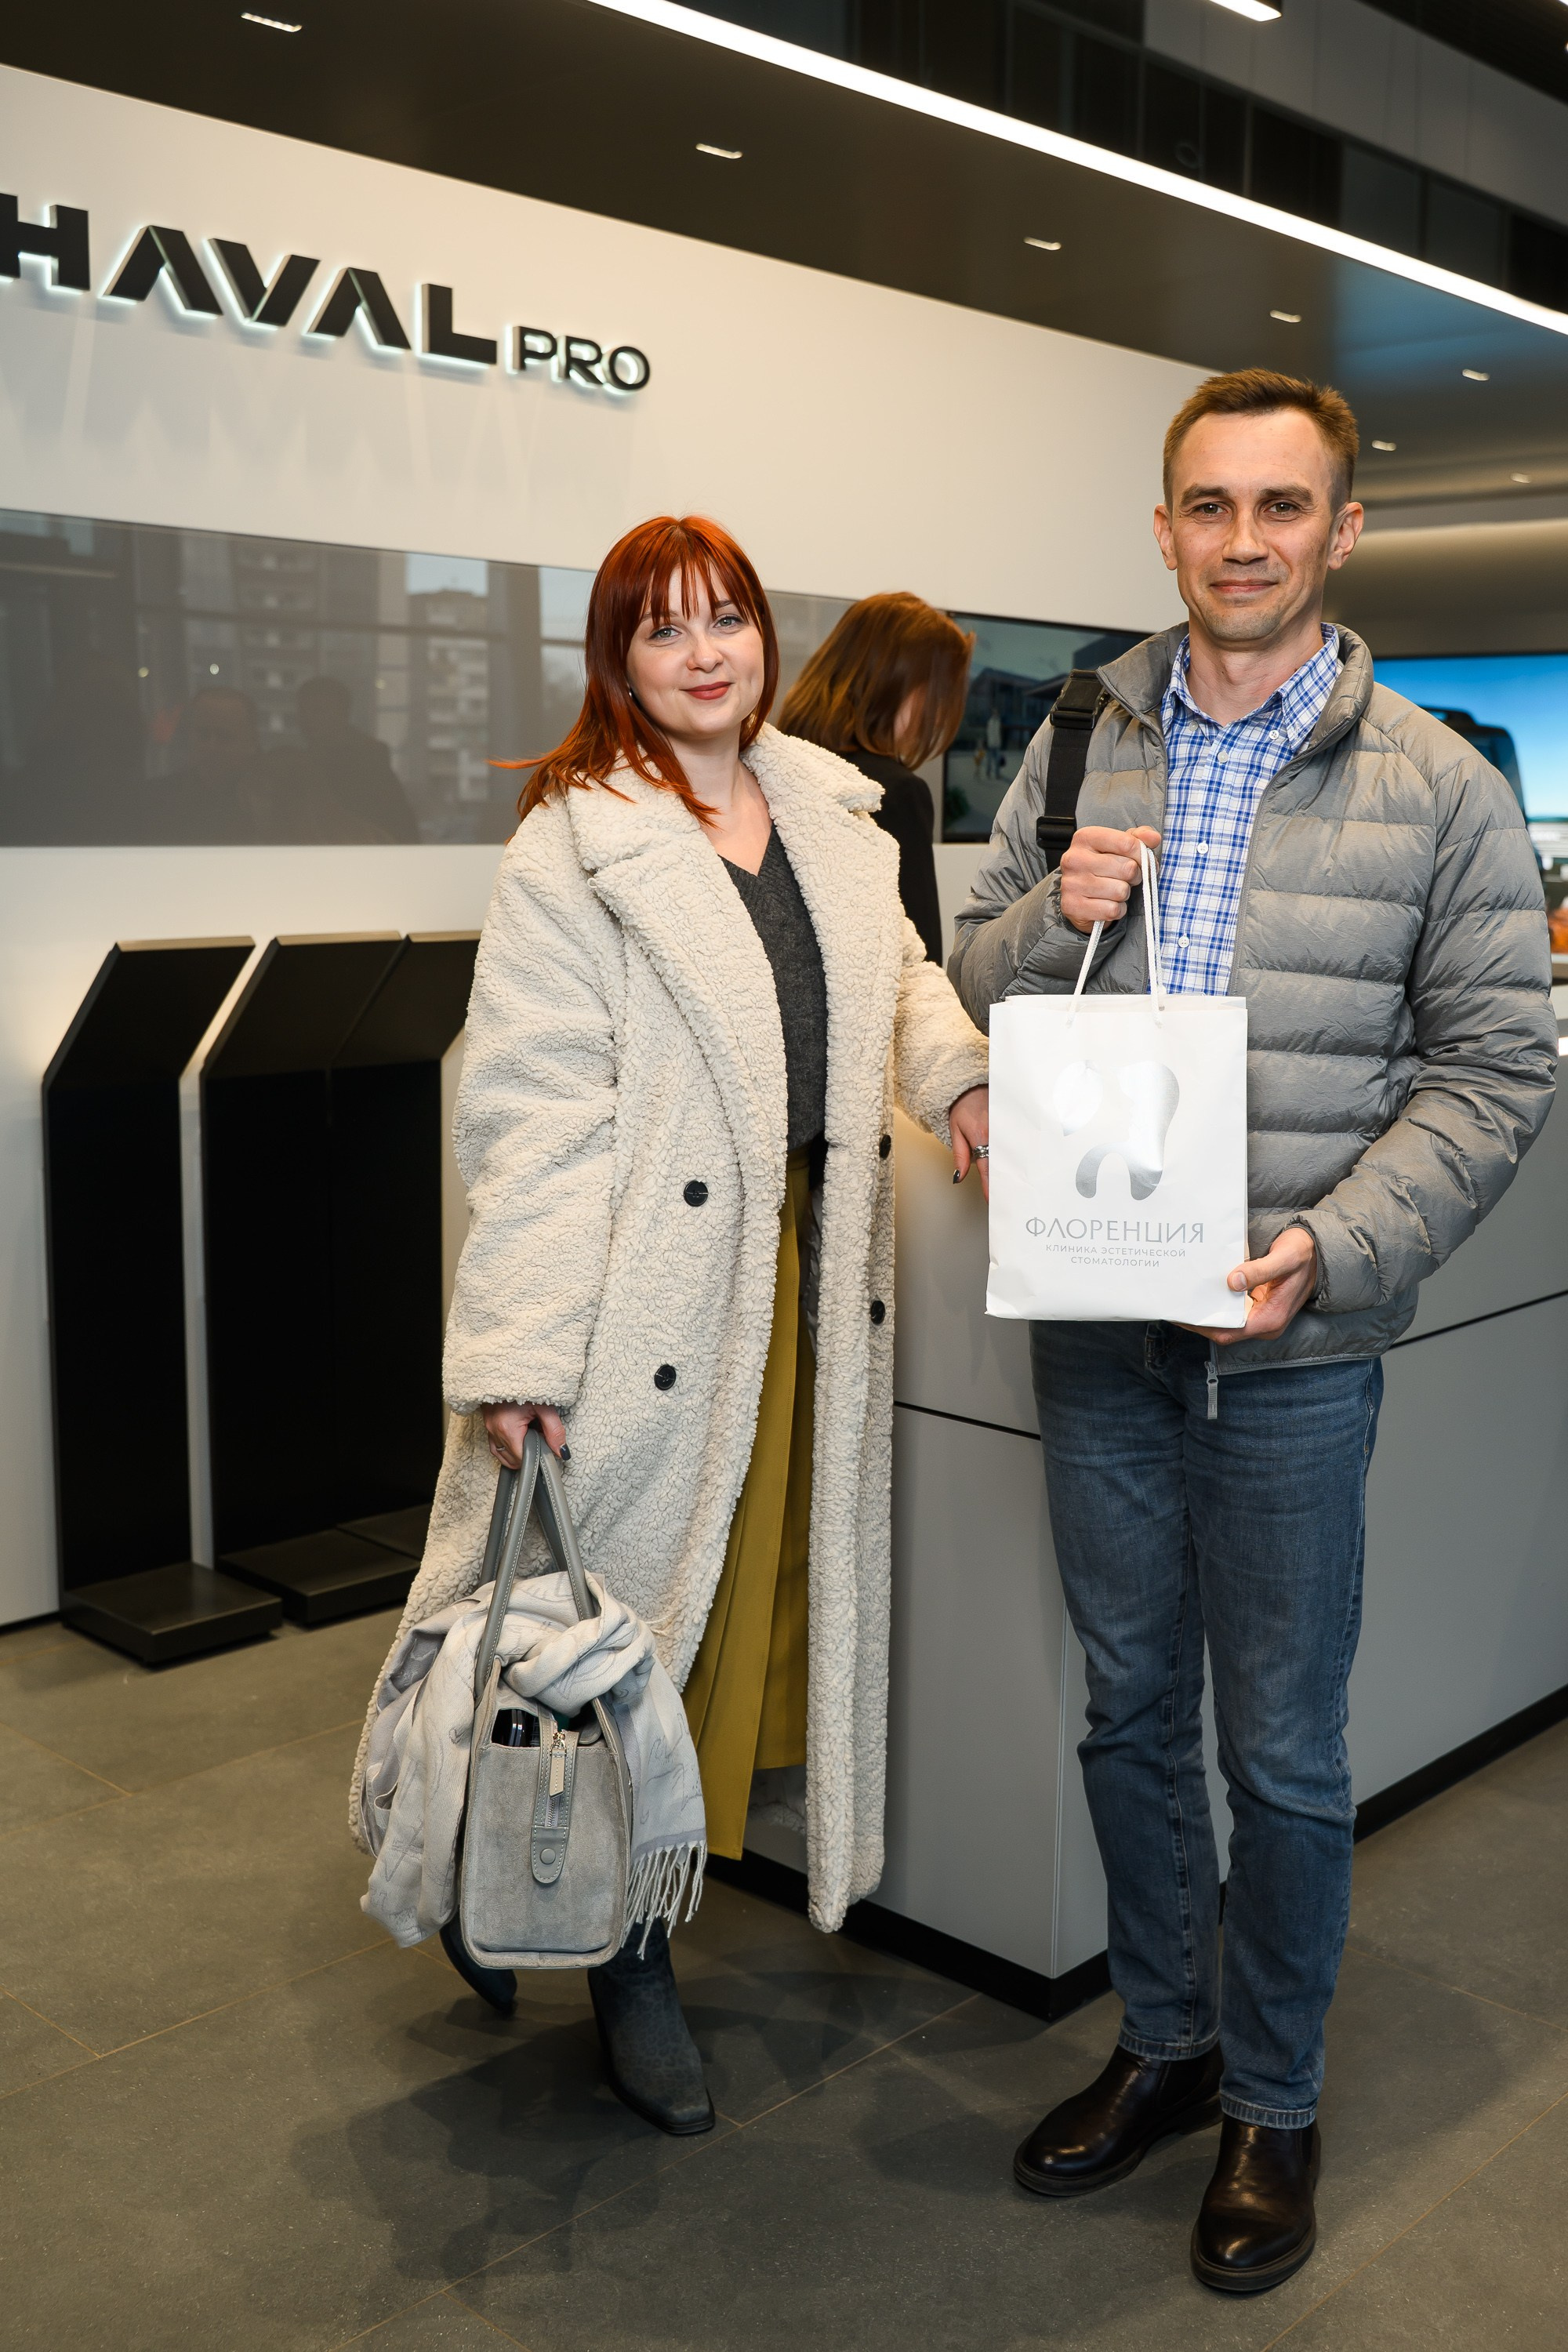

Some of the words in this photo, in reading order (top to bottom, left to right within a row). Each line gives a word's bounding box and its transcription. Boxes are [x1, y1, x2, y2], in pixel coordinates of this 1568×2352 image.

[0, 193, 498, 365] HAVAL
[512, 325, 651, 391] PRO
[1025, 1217, 1204, 1243] ФЛОРЕНЦИЯ
[1046, 1244, 1098, 1254] КЛИНИКА
[1101, 1247, 1186, 1258] ЭСТЕТИЧЕСКОЙ
[1071, 1256, 1160, 1268] СТОМАТОЛОГИИ
